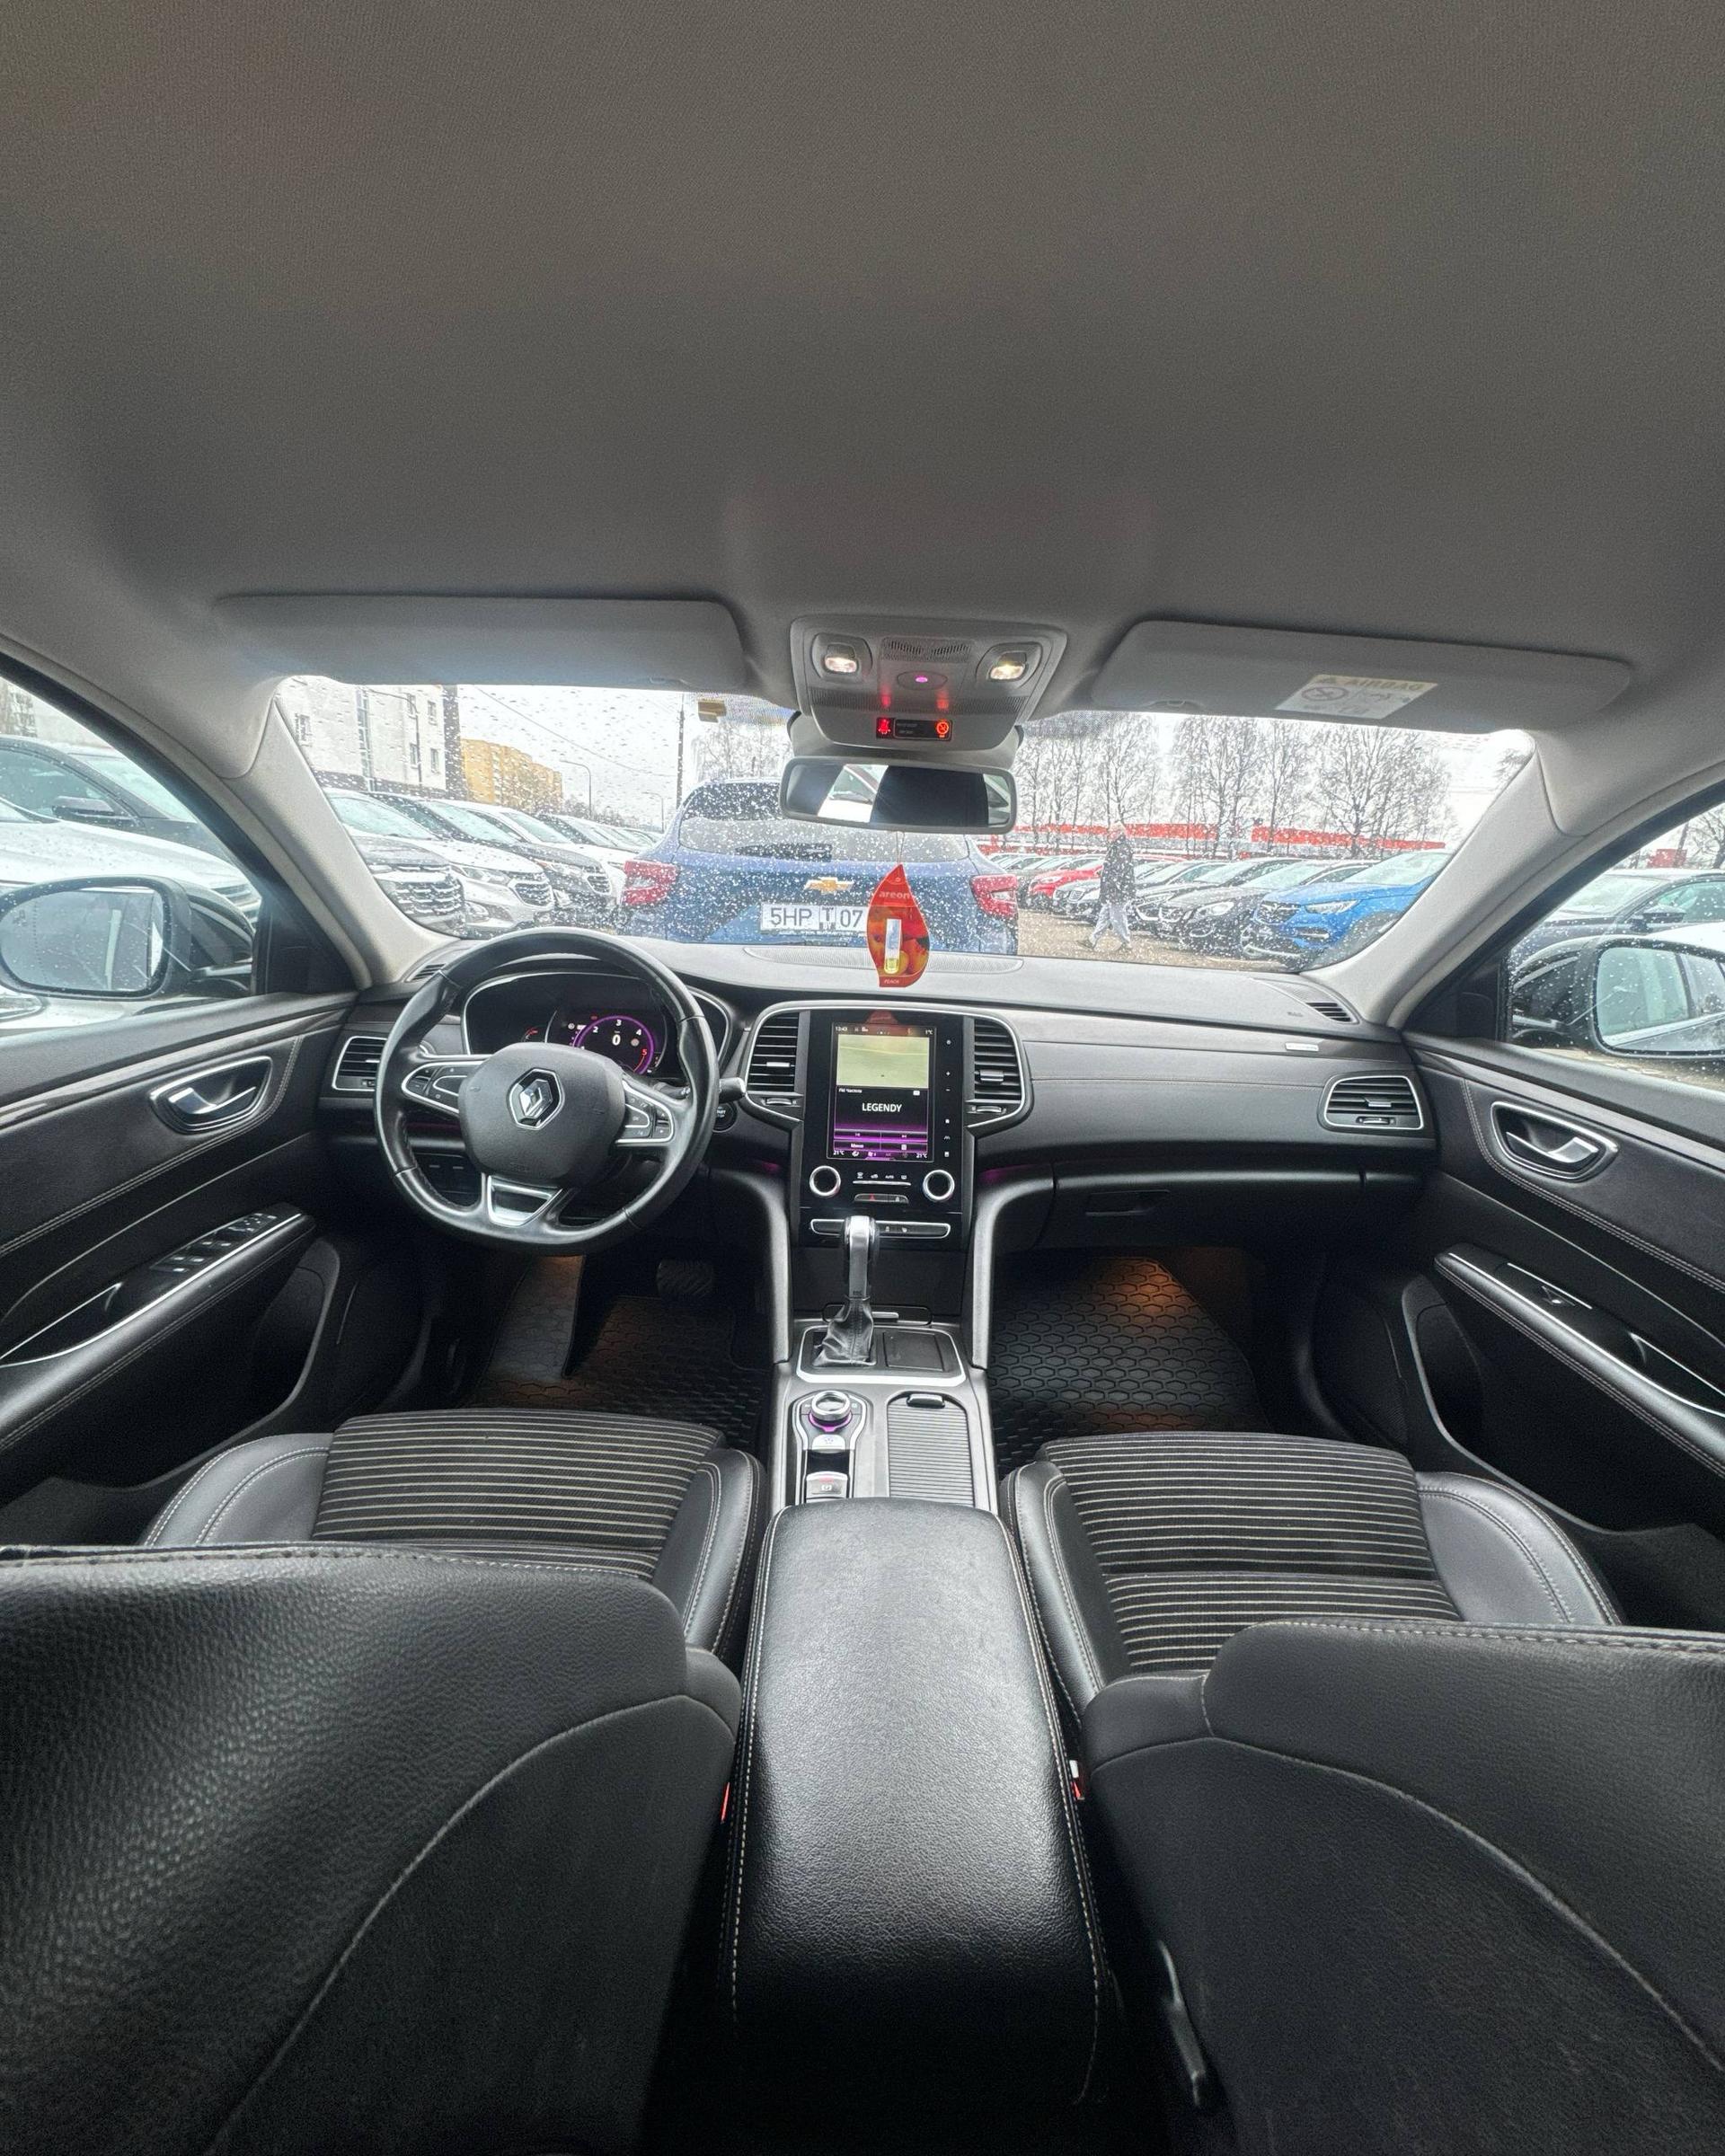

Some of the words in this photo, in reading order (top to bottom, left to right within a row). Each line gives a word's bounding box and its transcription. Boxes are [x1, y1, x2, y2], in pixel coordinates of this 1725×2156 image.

[879, 889, 910, 899] areon
[770, 907, 812, 926] 5HP
[840, 909, 863, 928] 07
[615, 1019, 622, 1027] 3
[612, 1034, 621, 1046] 0
[862, 1103, 902, 1112] LEGENDY
